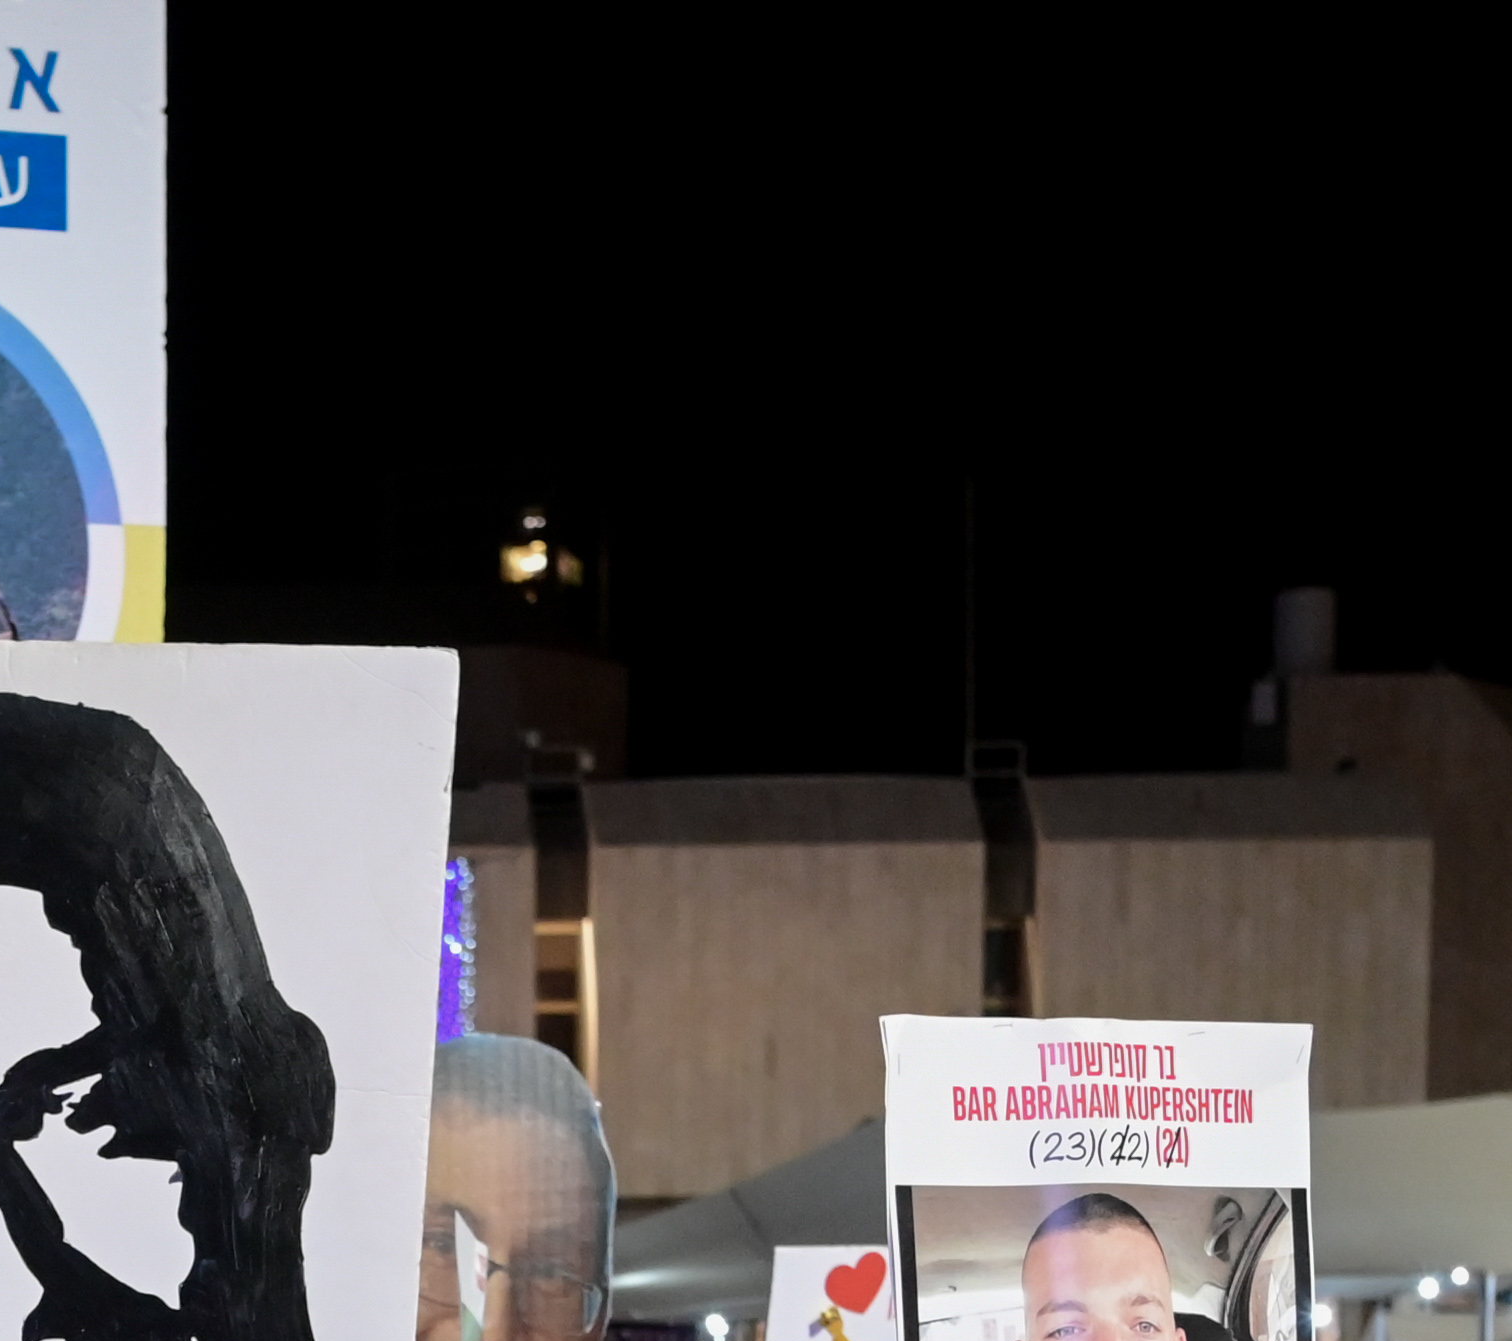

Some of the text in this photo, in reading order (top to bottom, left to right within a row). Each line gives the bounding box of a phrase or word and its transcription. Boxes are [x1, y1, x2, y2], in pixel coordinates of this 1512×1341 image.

[1038, 1042, 1176, 1082] בר קופרשטיין
[952, 1086, 1254, 1125] BAR ABRAHAM KUPERSHTEIN
